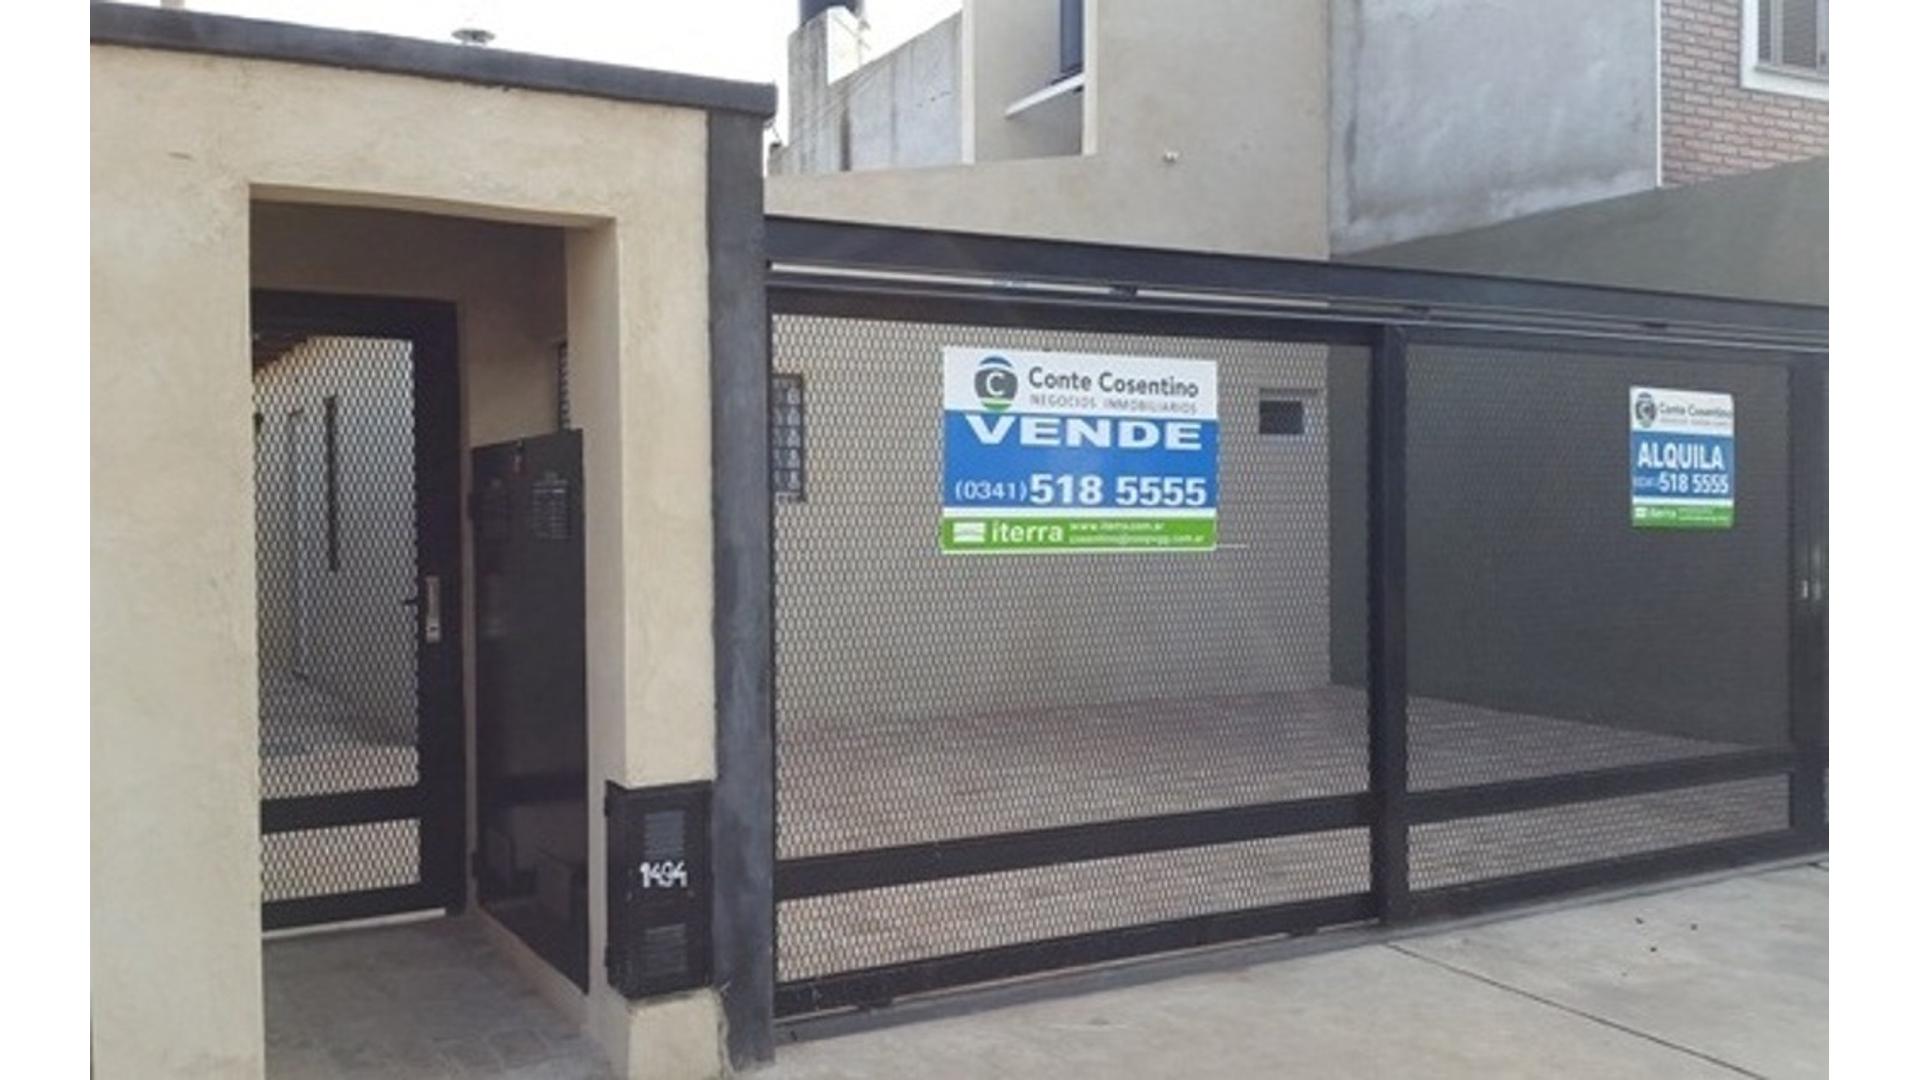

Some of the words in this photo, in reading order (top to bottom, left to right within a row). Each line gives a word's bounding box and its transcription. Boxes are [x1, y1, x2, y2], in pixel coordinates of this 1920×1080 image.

[1028, 366, 1092, 390] Conte
[1099, 371, 1199, 398] Cosentino
[1029, 393, 1098, 408] NEGOCIOS
[965, 414, 1203, 450] VENDE
[1637, 441, 1724, 470] ALQUILA
[955, 480, 1028, 500] (0341)
[1030, 473, 1104, 504] 518
[1115, 476, 1207, 506] 5555
[1658, 472, 1689, 493] 518
[1691, 473, 1729, 494] 5555
